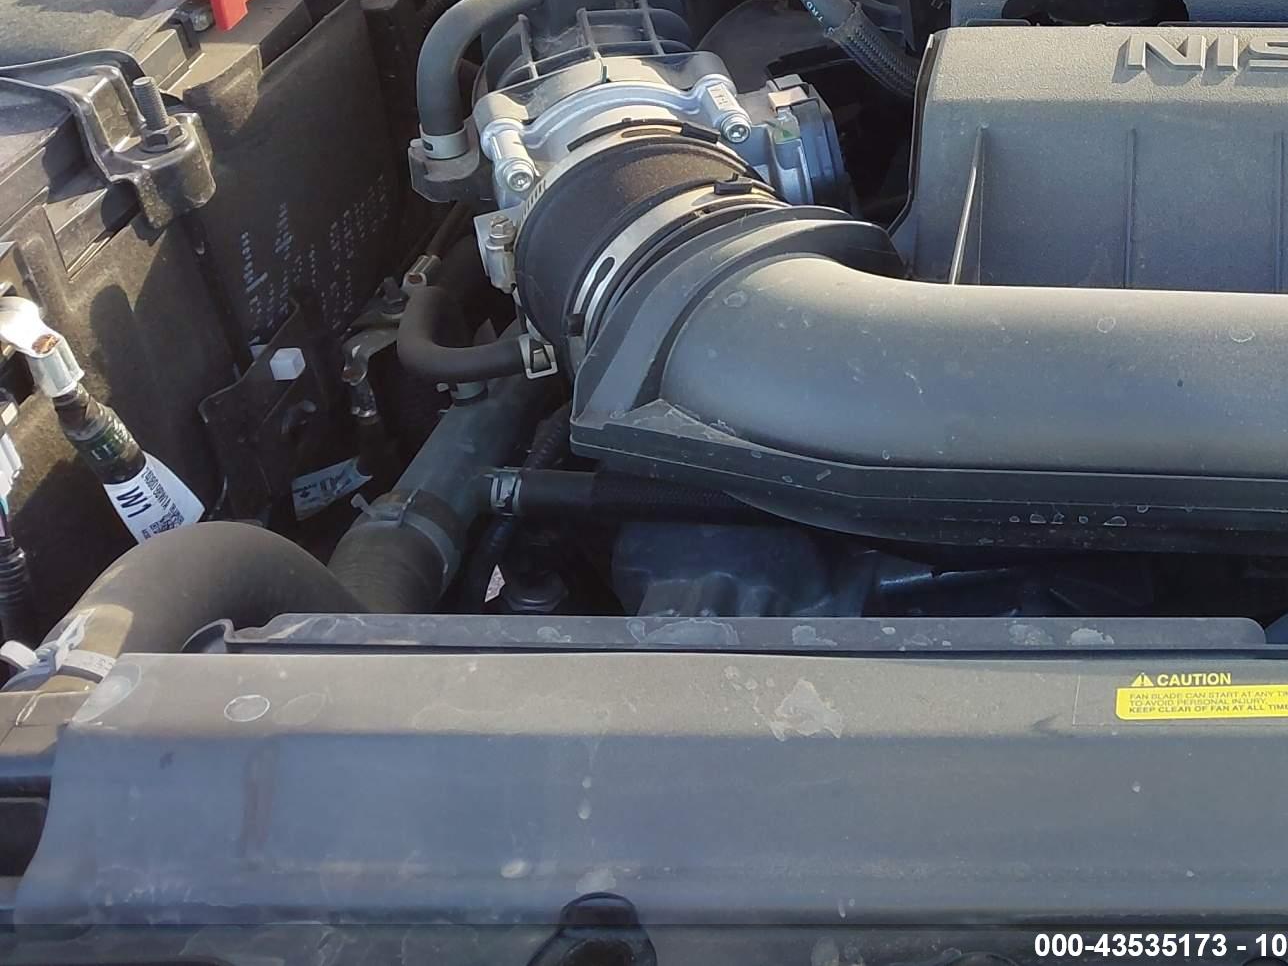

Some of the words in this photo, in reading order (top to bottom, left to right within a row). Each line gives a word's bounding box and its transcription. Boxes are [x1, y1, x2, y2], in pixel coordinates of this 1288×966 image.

[116, 485, 152, 518] W1
[1156, 672, 1232, 686] CAUTION
[1151, 692, 1182, 700] BLADE
